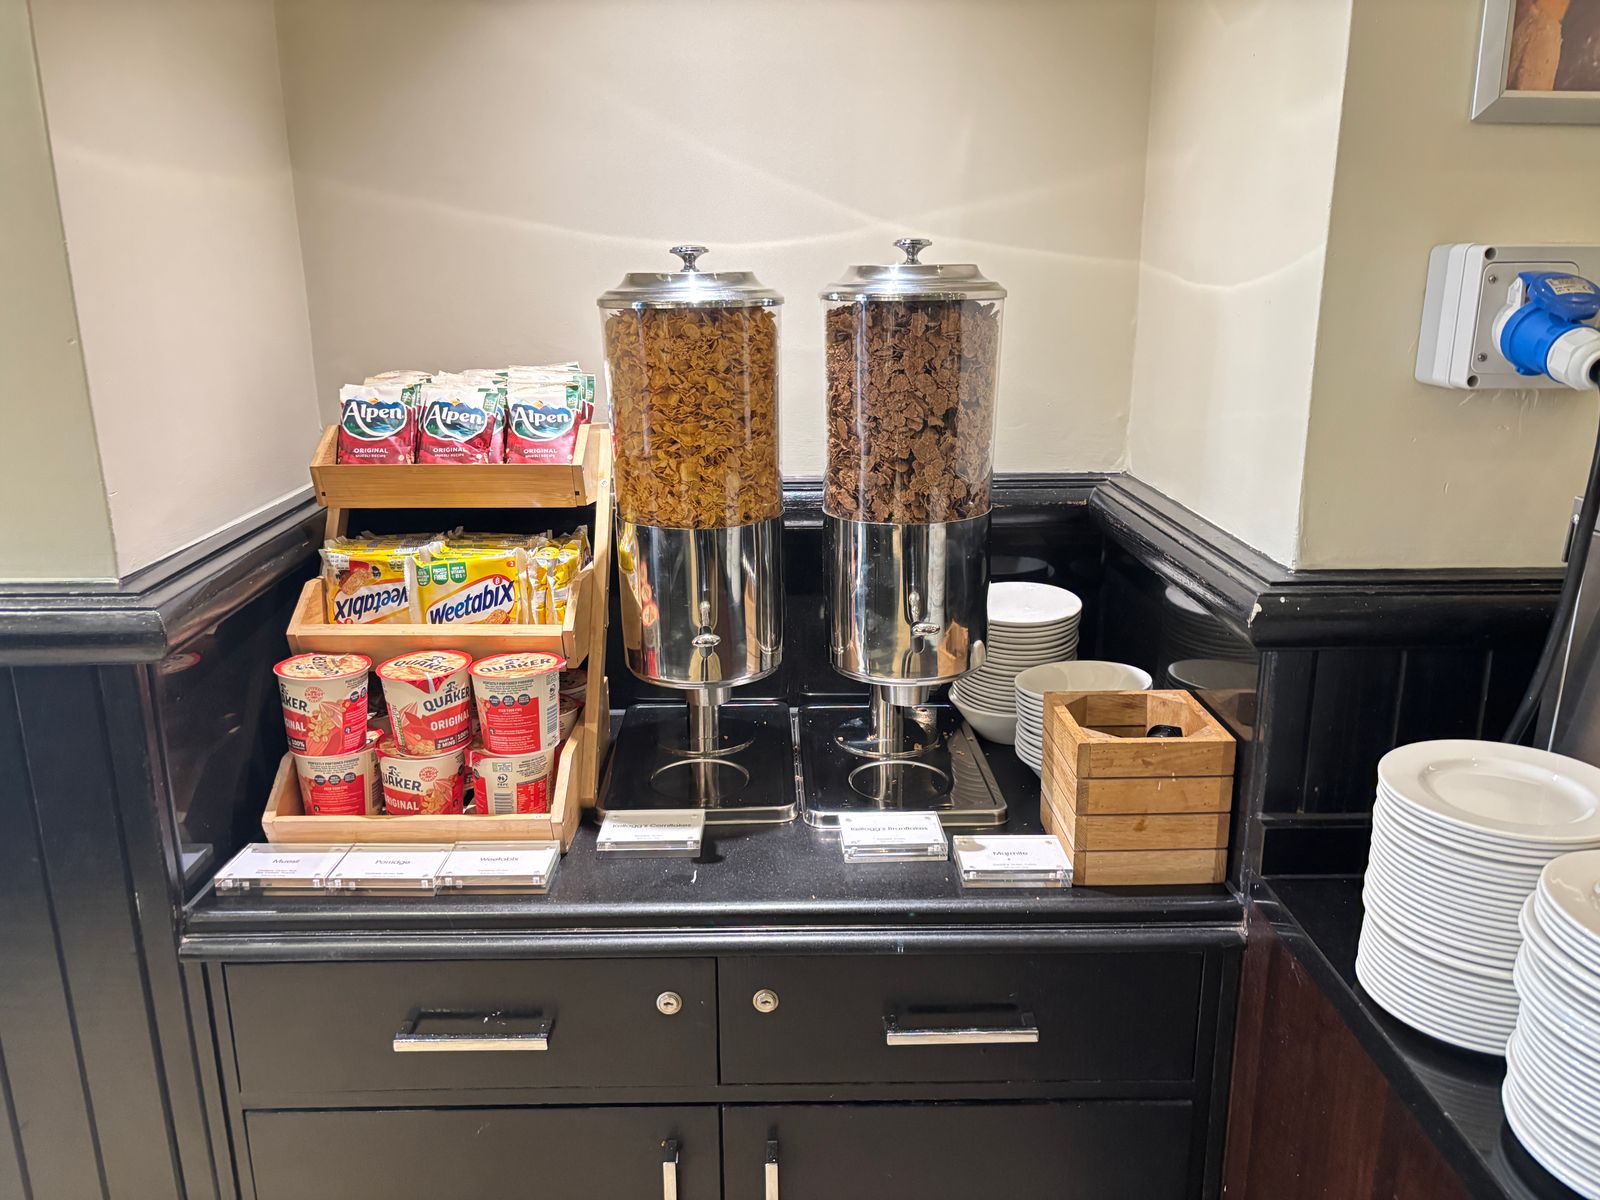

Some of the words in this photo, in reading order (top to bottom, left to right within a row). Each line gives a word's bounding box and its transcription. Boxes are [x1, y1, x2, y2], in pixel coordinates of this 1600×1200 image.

[343, 401, 403, 435] Alpen
[425, 404, 484, 437] Alpen
[512, 407, 570, 437] Alpen
[430, 580, 515, 624] Weetabix
[393, 659, 455, 673] QUAKER
[479, 658, 552, 673] QUAKER
[422, 685, 471, 712] QUAKER
[430, 709, 470, 732] ORIGINAL
